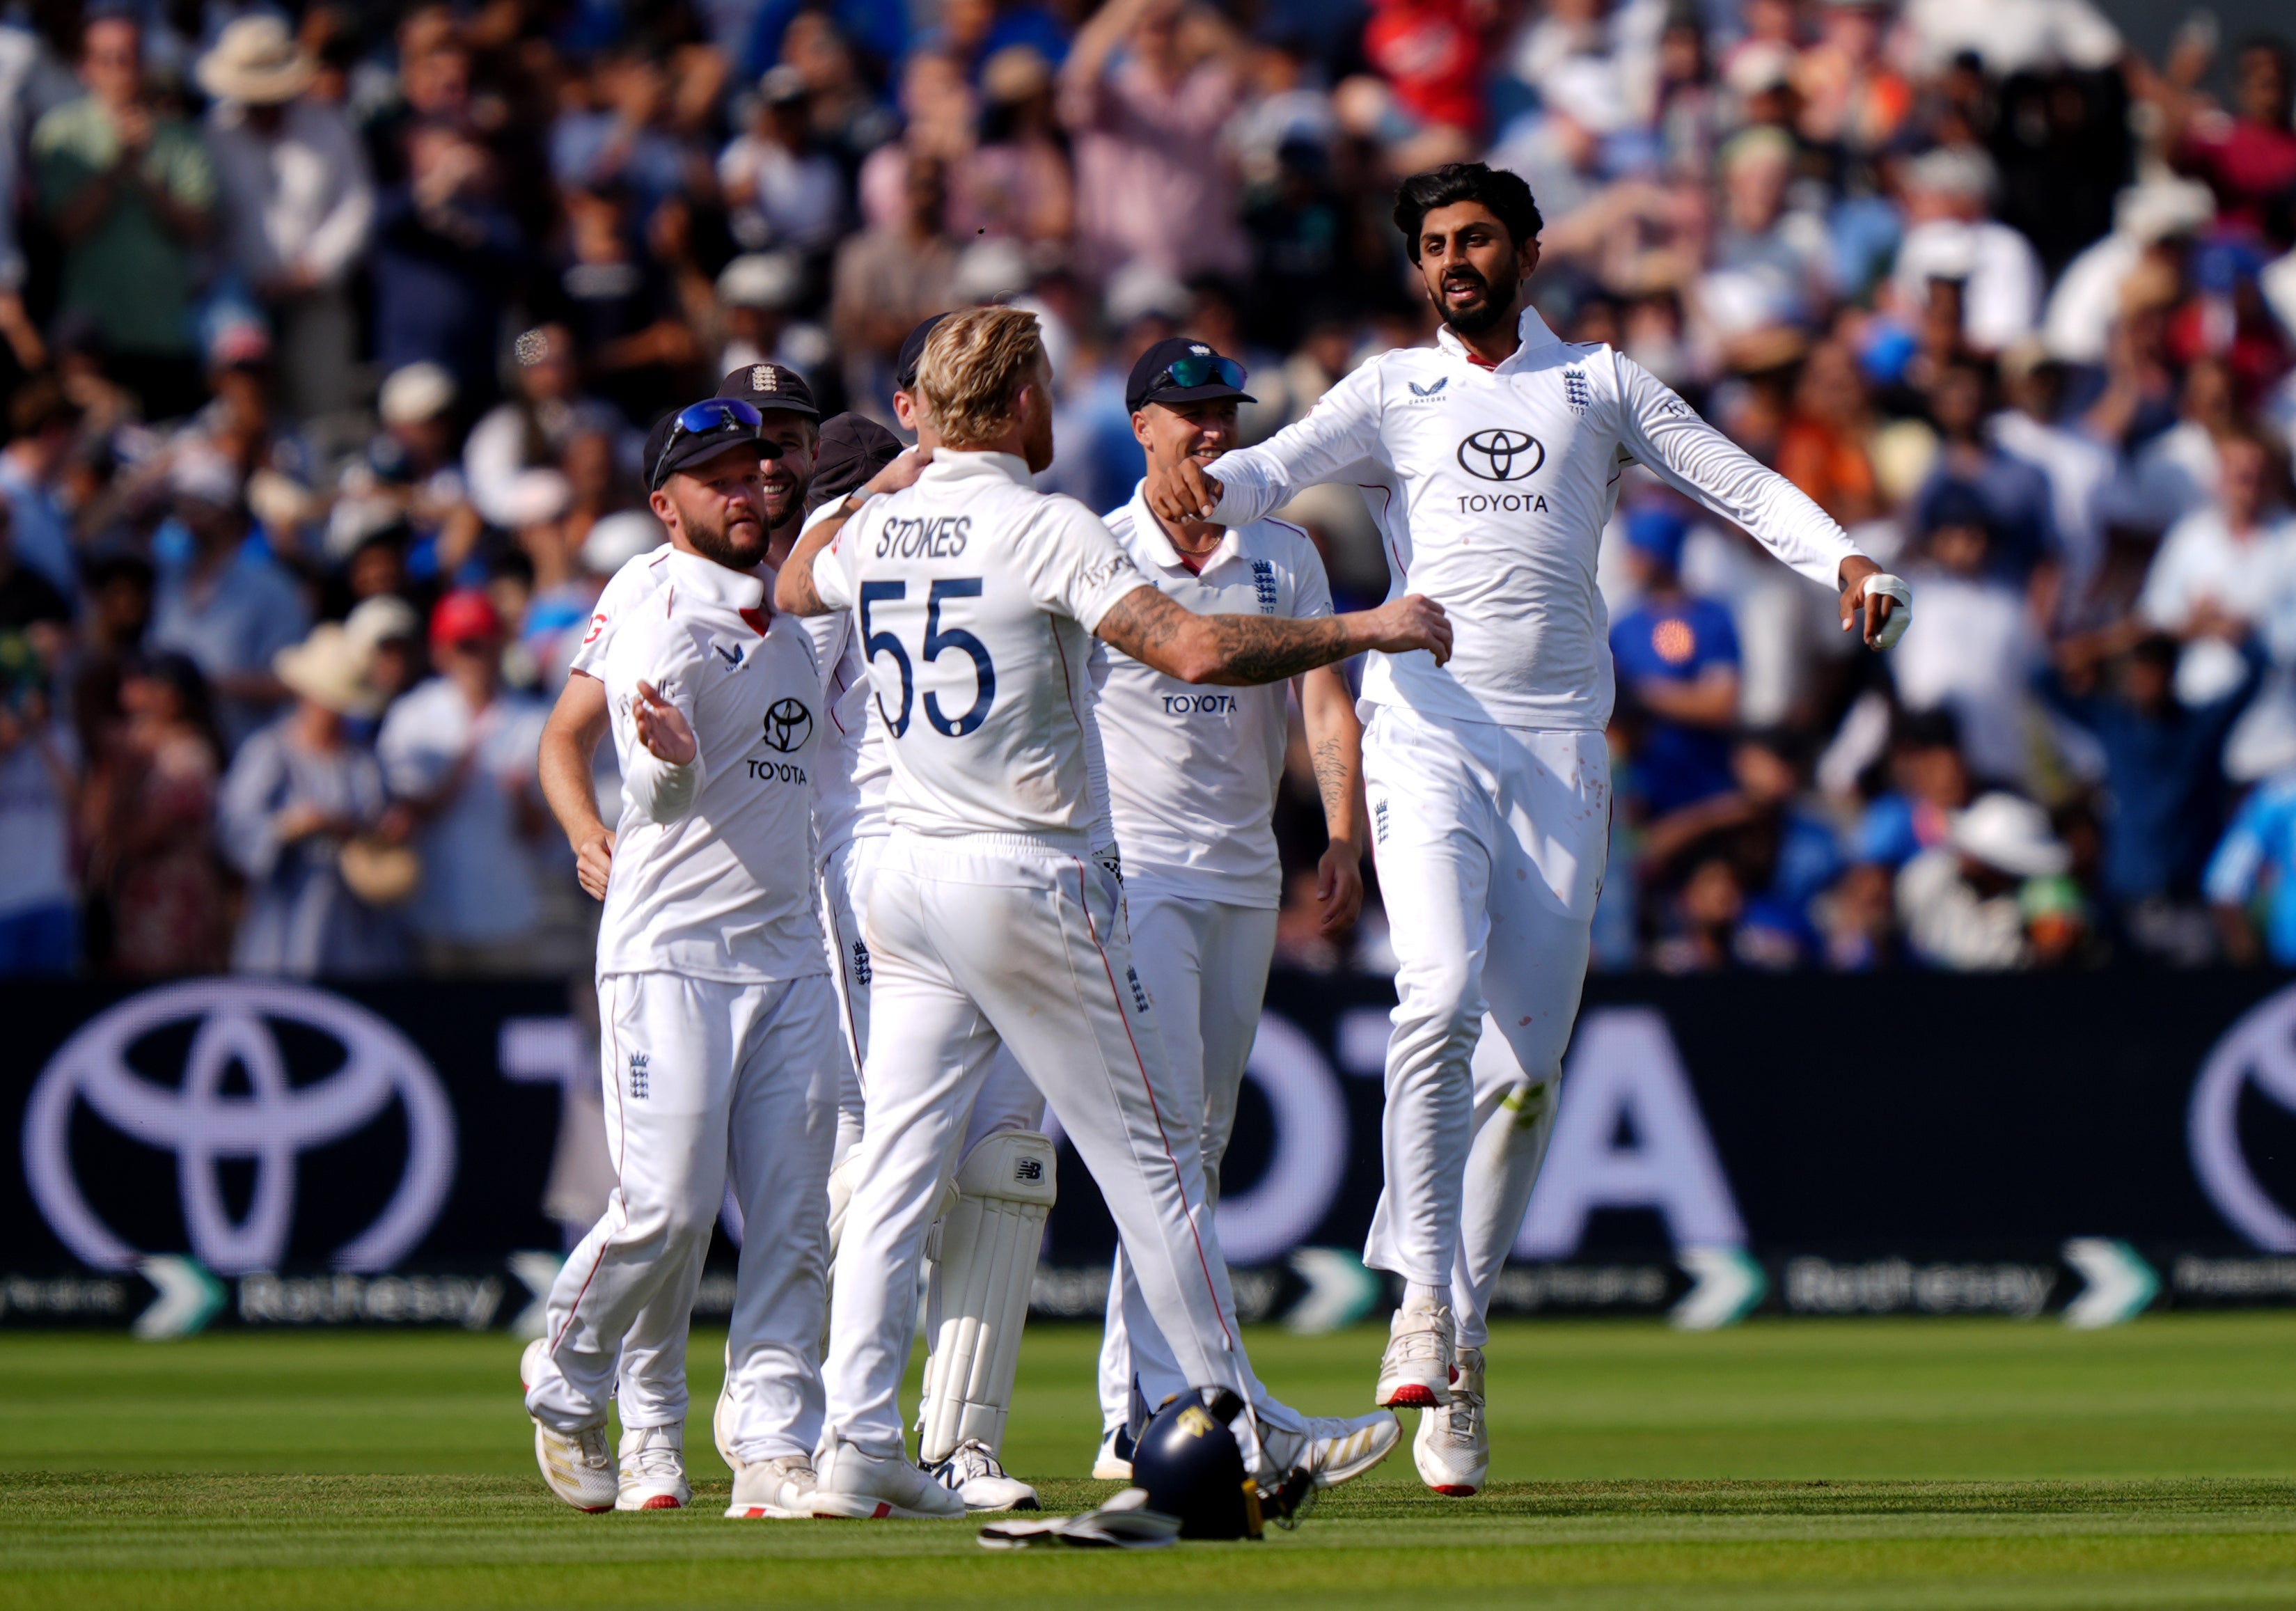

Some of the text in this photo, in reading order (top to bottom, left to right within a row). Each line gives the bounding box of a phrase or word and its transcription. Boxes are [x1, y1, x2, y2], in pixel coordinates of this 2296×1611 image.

[1457, 494, 1549, 514] TOYOTA
[876, 515, 972, 559] STOKES
[860, 577, 996, 739] 55
[1162, 695, 1237, 714] TOYOTA
[747, 760, 807, 786] TOYOTA
